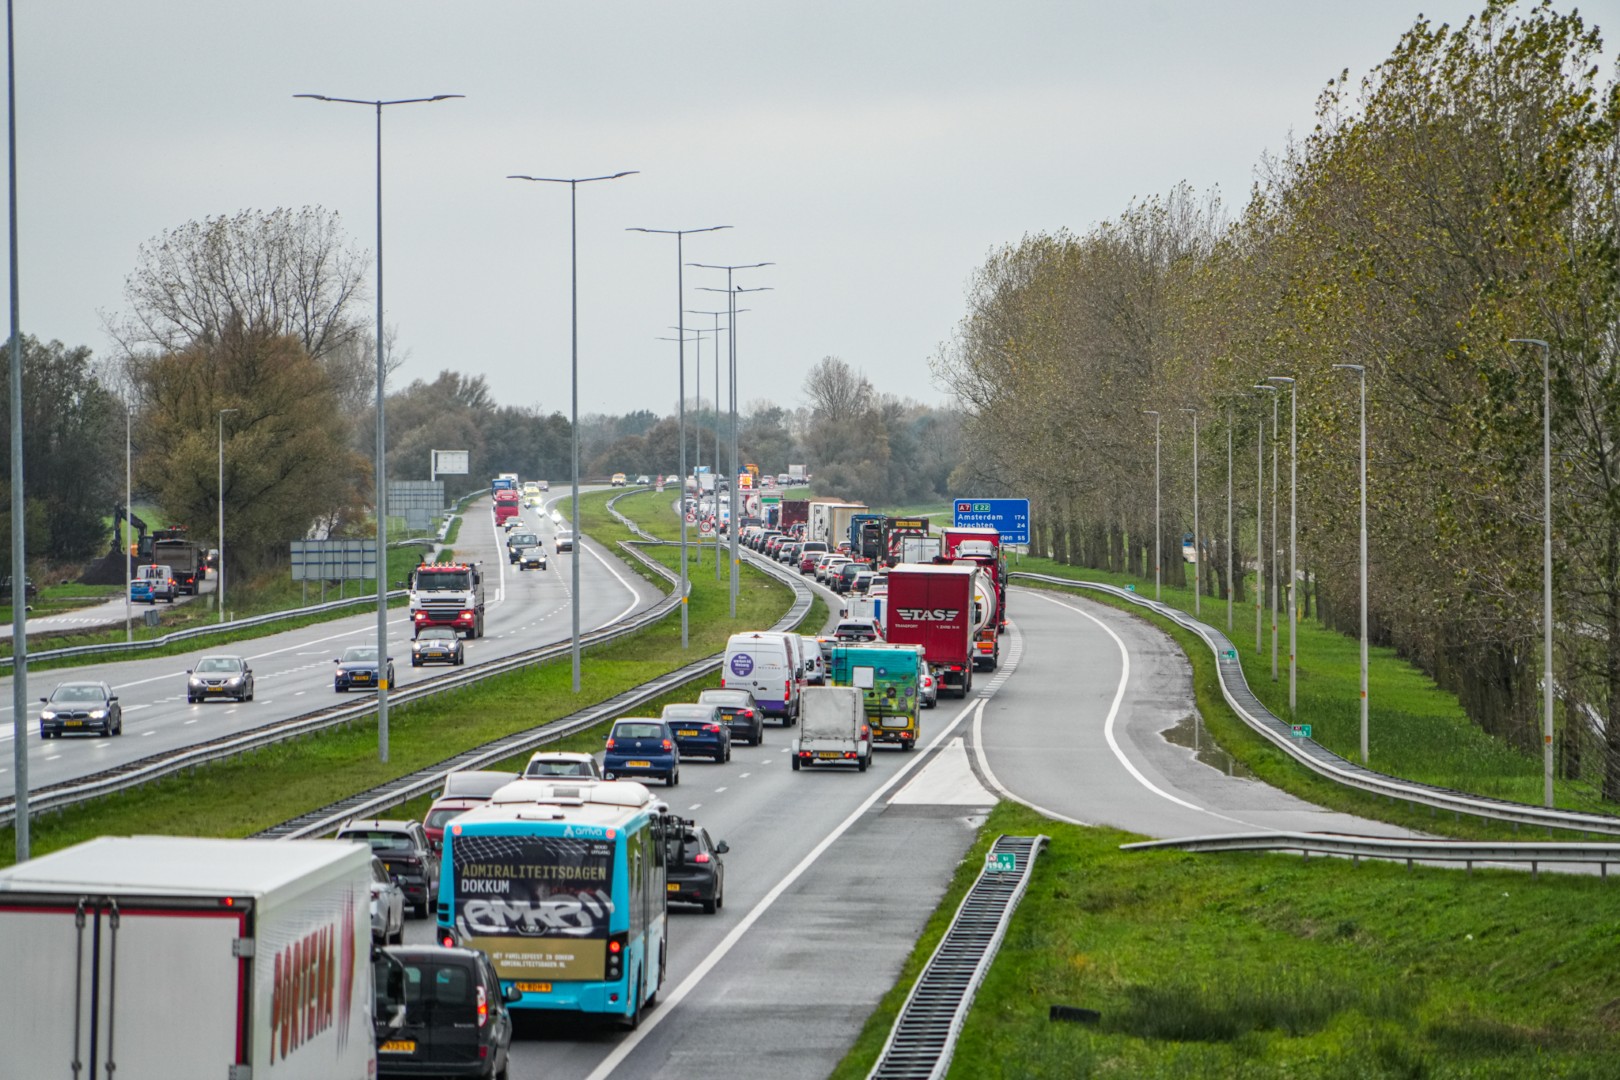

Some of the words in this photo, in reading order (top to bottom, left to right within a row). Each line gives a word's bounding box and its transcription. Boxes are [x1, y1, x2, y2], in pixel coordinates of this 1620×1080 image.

[909, 609, 946, 621] TAS
[575, 827, 602, 836] arriva
[461, 864, 607, 880] ADMIRALITEITSDAGEN
[461, 879, 510, 893] DOKKUM
